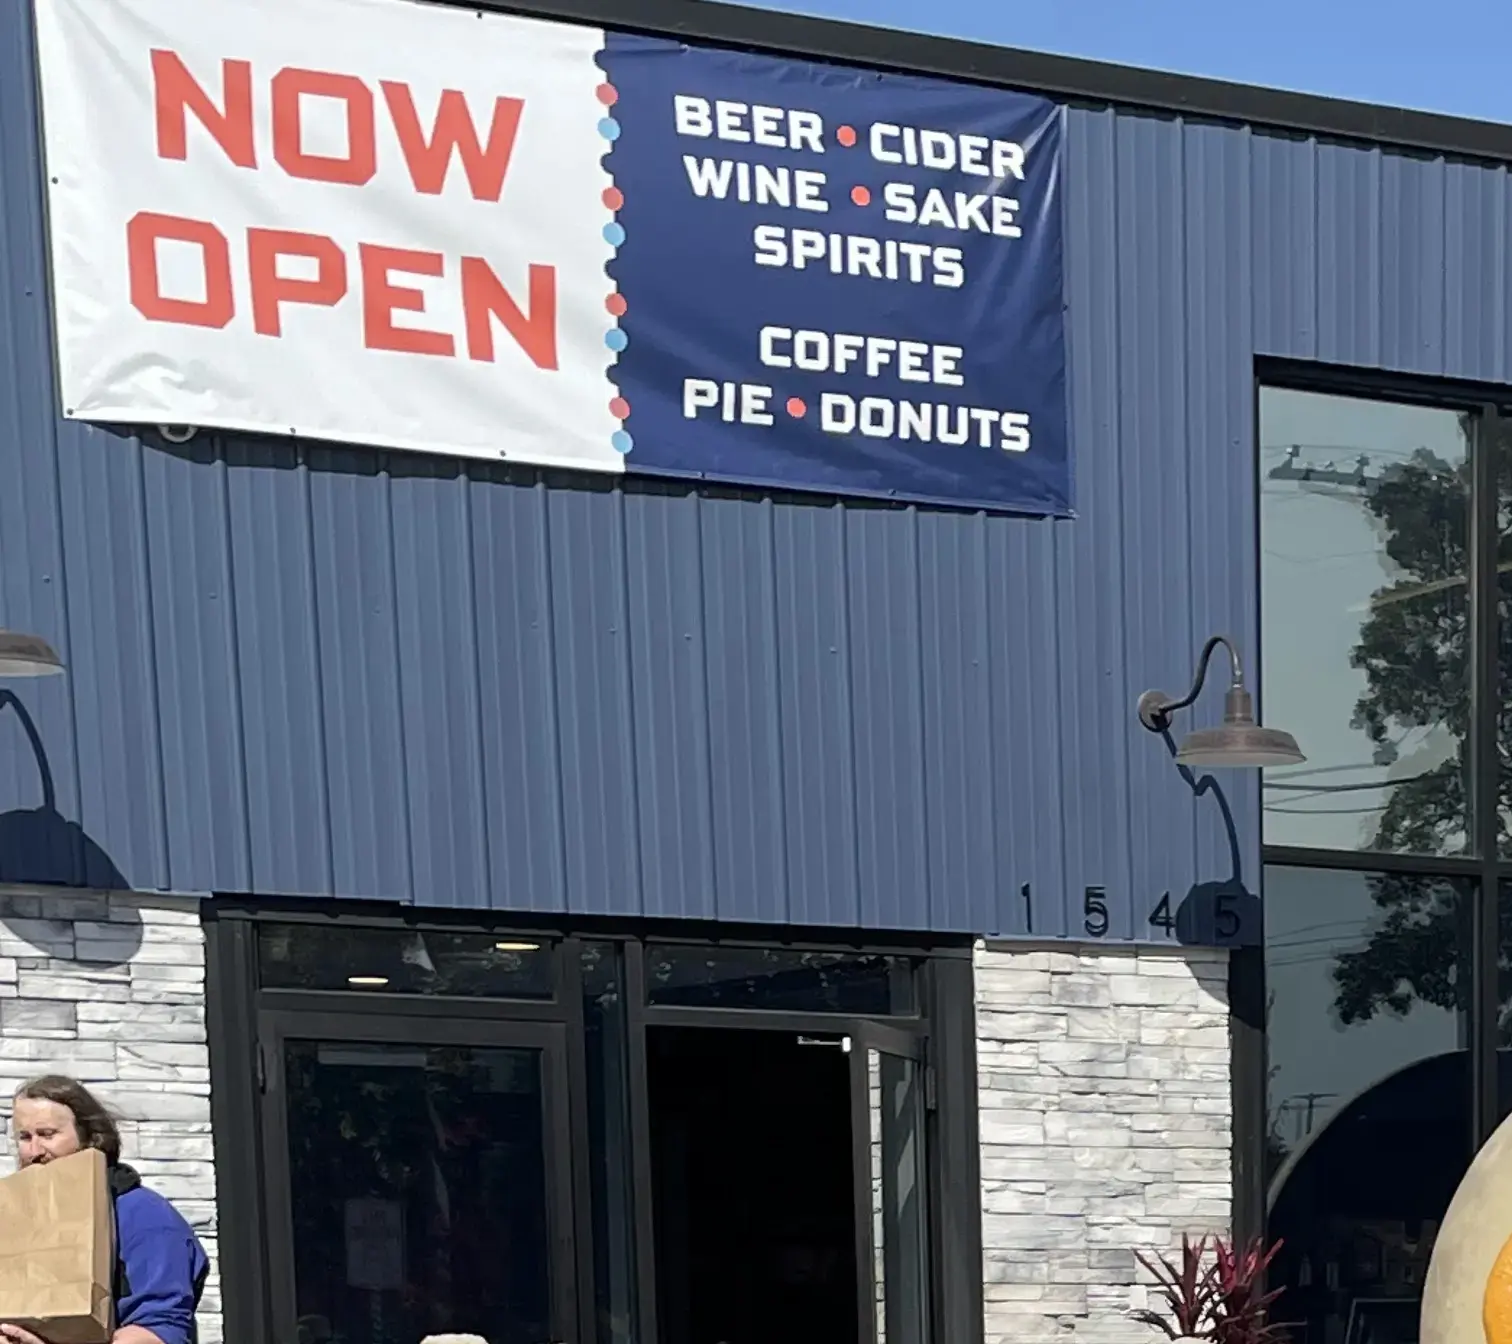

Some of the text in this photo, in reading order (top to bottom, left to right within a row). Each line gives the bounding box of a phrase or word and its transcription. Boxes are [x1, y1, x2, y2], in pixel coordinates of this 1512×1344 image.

[150, 47, 526, 204] NOW
[673, 95, 1026, 181] BEER CIDER
[682, 155, 1023, 239] WINE SAKE
[126, 210, 559, 371] OPEN
[753, 224, 965, 289] SPIRITS
[759, 325, 965, 387] COFFEE
[682, 378, 1031, 453] PIE DONUTS
